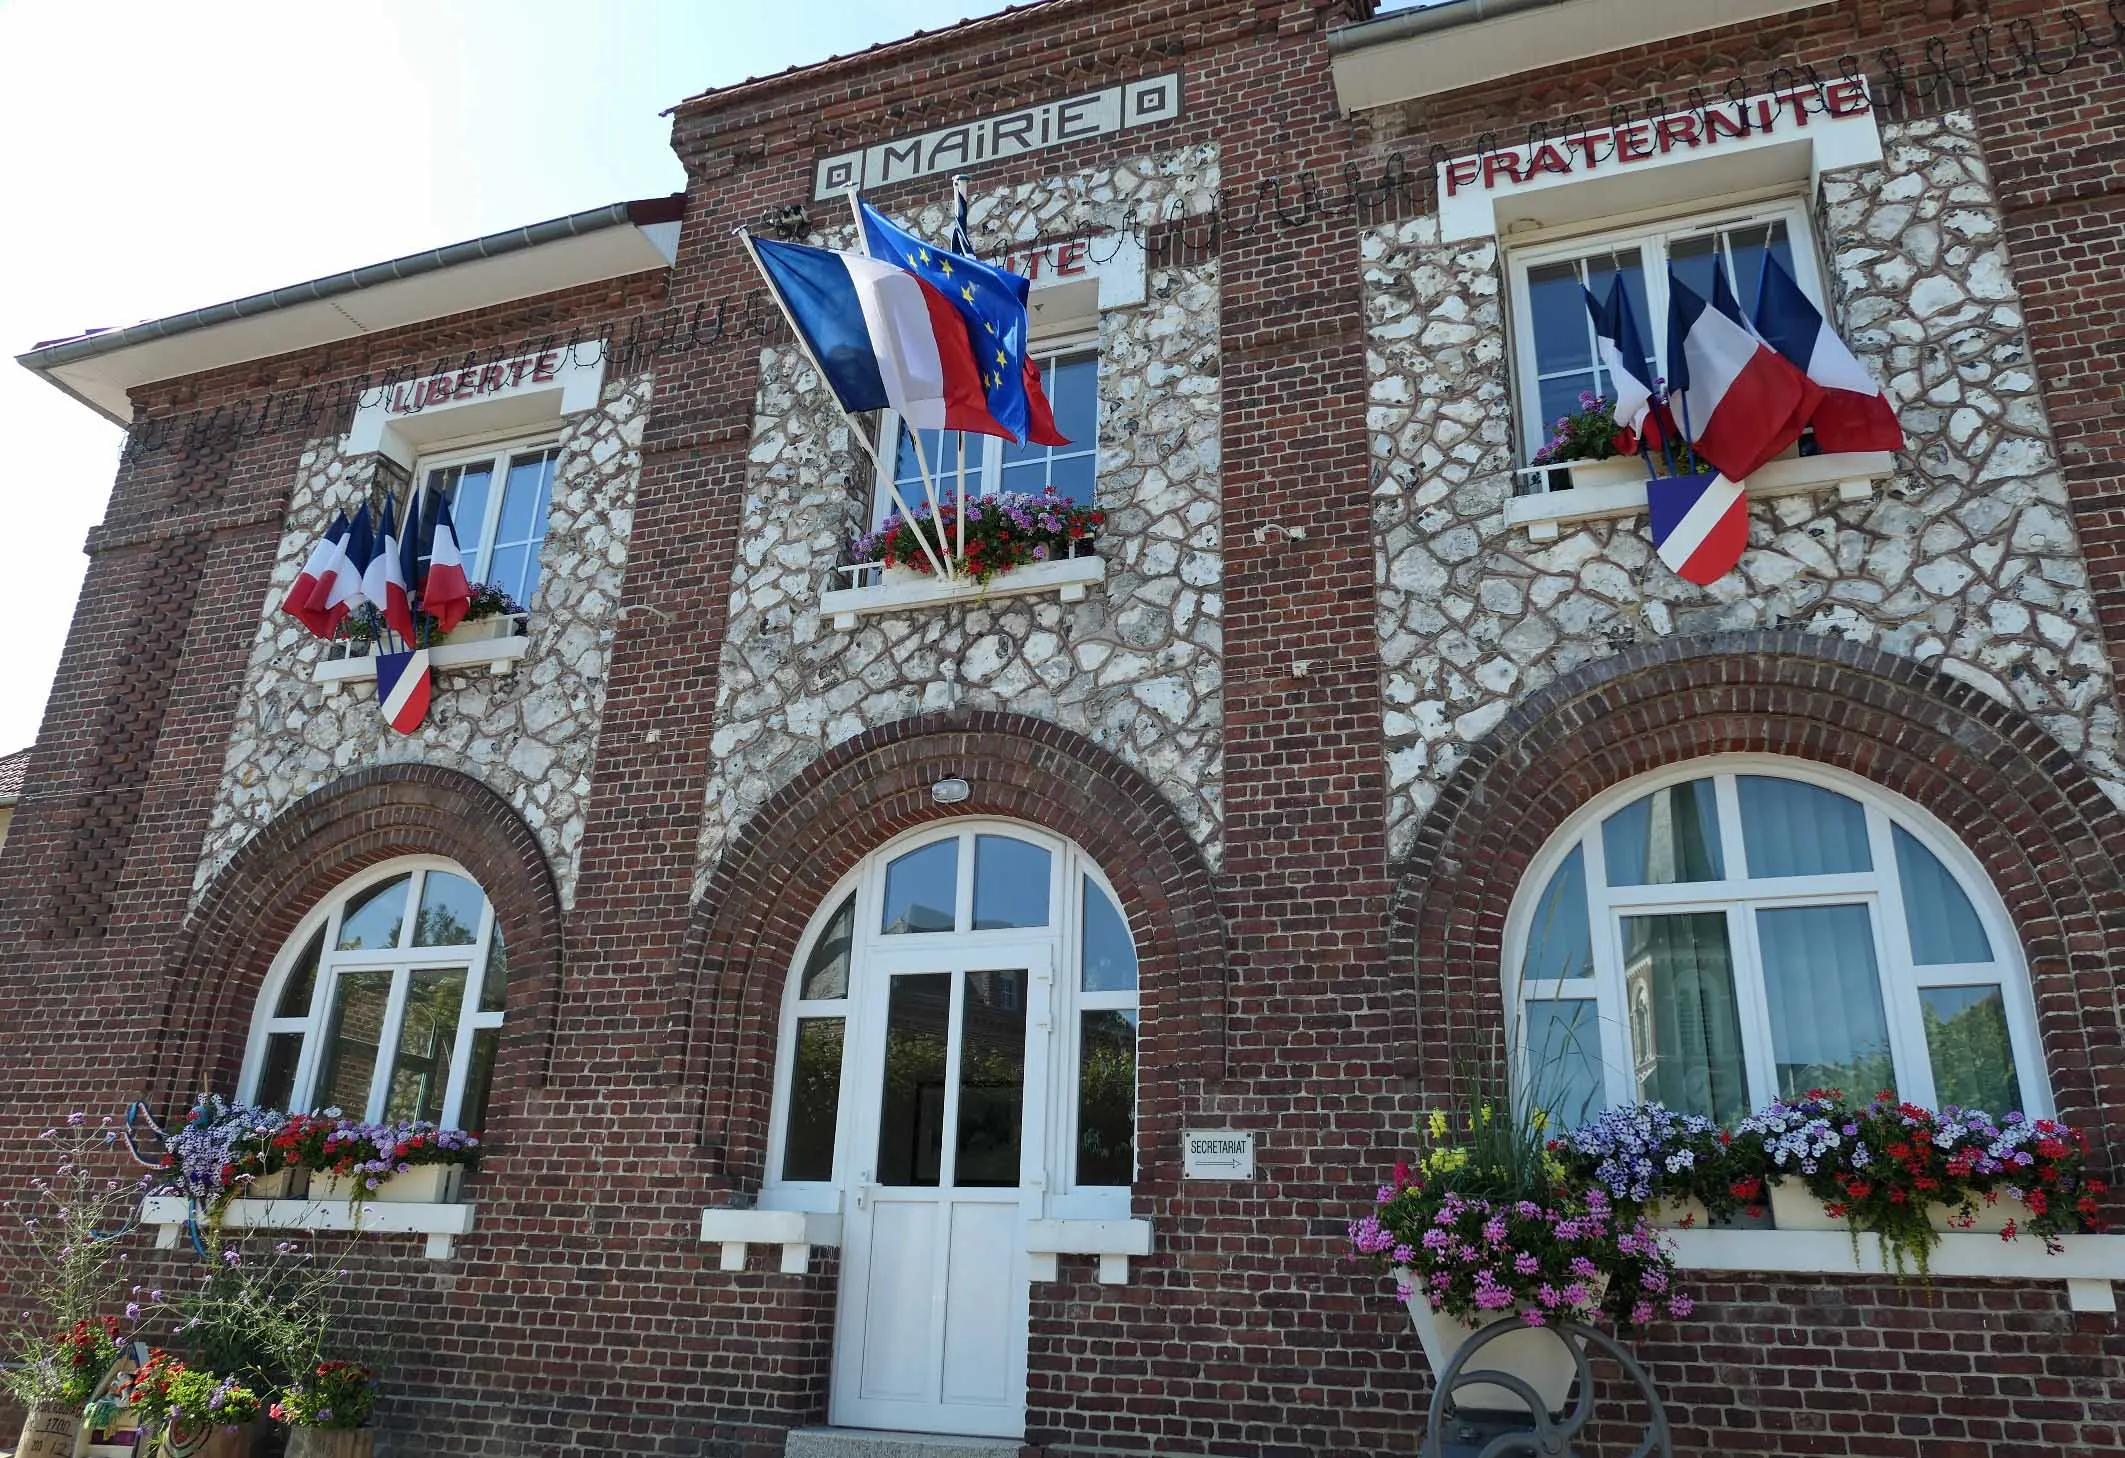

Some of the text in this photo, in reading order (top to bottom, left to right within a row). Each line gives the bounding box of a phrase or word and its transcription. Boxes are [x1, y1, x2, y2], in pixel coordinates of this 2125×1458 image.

[1446, 79, 1868, 196] FRATERNITE
[391, 352, 559, 413] LIBERTE
[1190, 1140, 1247, 1154] SECRETARIAT
